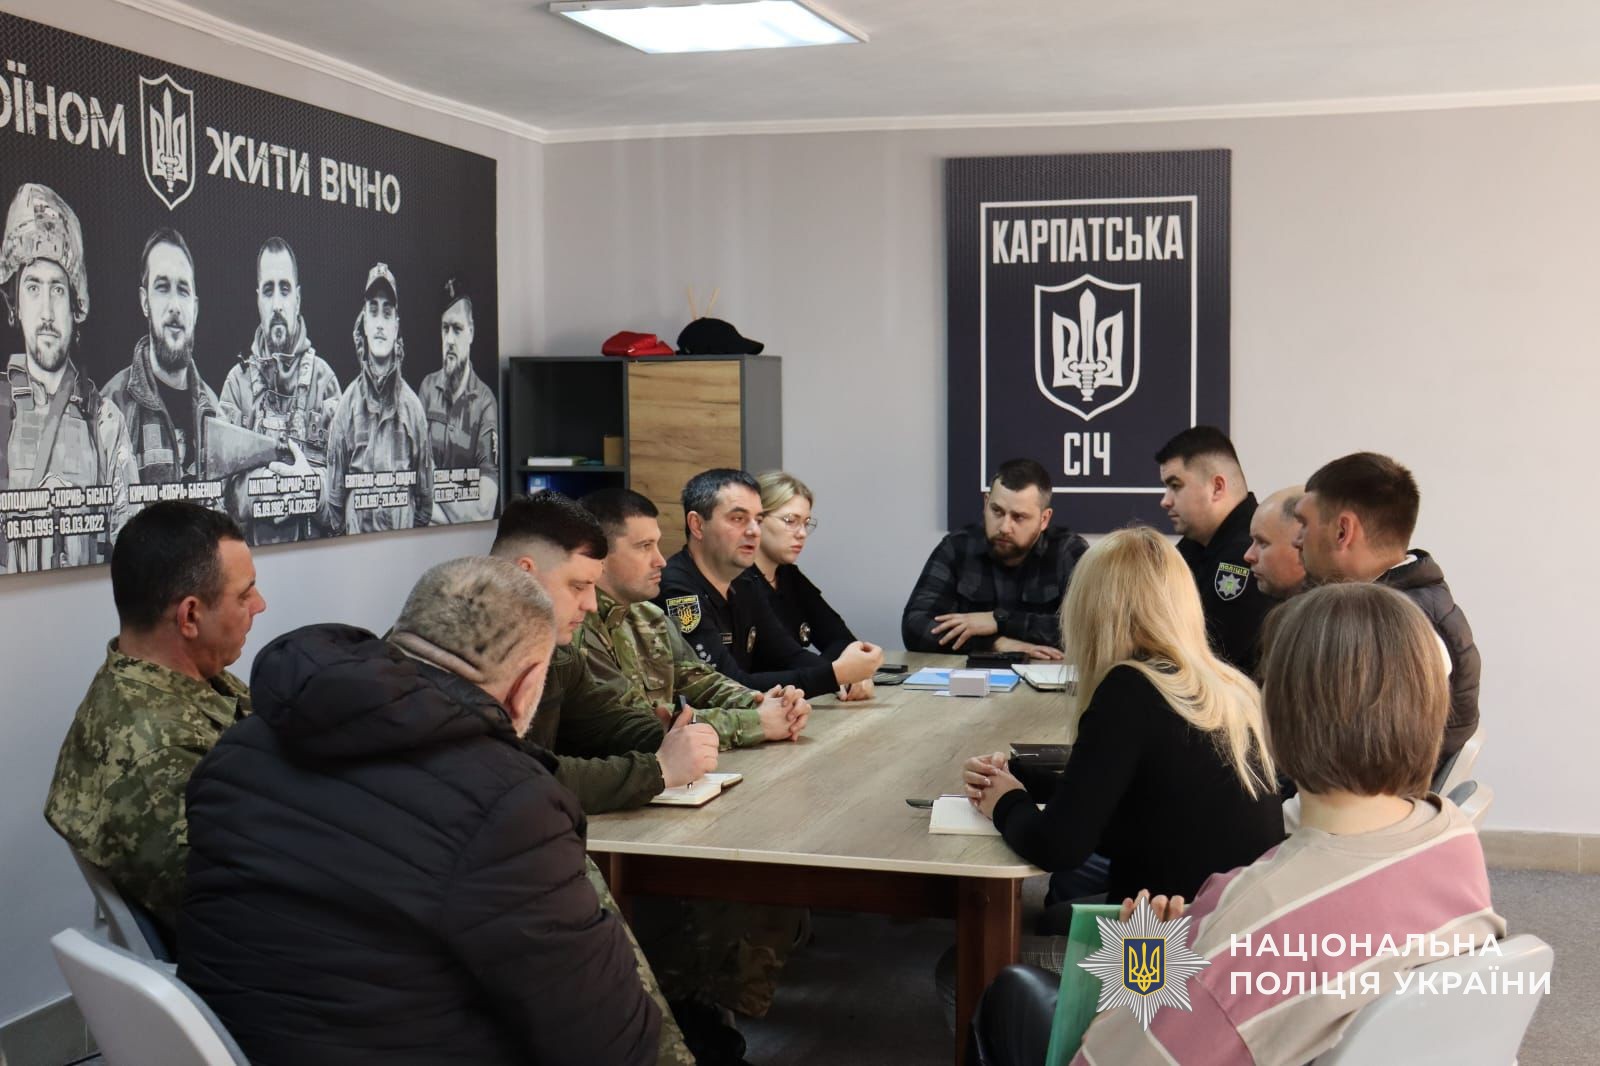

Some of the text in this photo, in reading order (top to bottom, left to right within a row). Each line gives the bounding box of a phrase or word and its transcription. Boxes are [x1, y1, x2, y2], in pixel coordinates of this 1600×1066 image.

[206, 127, 310, 196] ЖИТИ
[321, 158, 401, 214] ВІЧНО
[992, 215, 1184, 264] КАРПАТСЬКА
[1063, 432, 1111, 476] СІЧ
[0, 489, 50, 512] ОЛОДИМИР
[86, 486, 113, 505] БІСАГА
[7, 518, 53, 539] 06.09.1993
[60, 513, 104, 535] 03.03.2022
